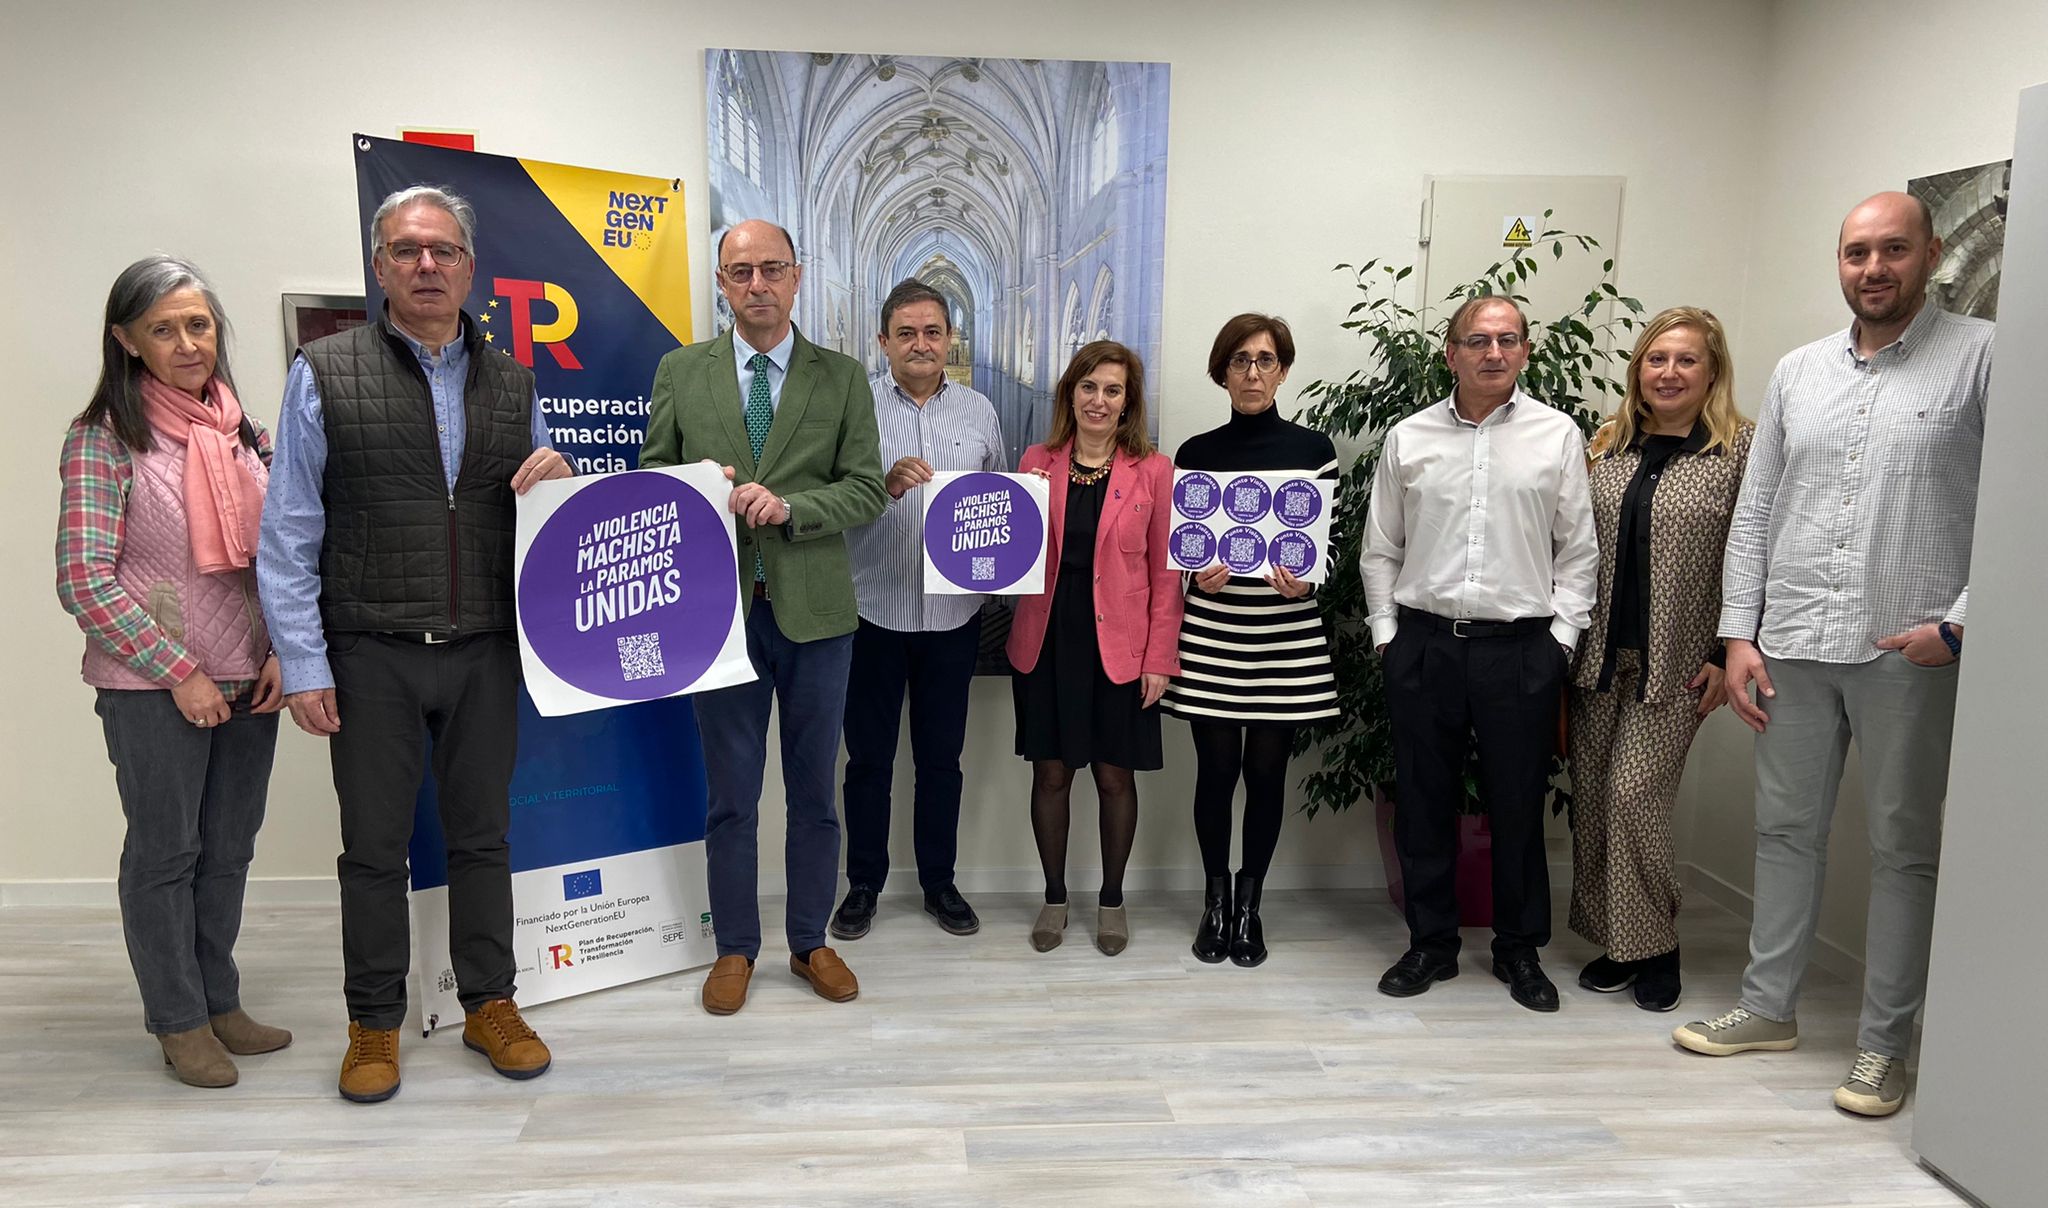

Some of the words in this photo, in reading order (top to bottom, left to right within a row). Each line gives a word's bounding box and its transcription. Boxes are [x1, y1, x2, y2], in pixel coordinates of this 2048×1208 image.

[603, 229, 632, 248] EU
[1180, 474, 1198, 485] Punto
[1200, 474, 1217, 490] Violeta
[1230, 478, 1248, 489] Punto
[1250, 477, 1267, 493] Violeta
[1280, 482, 1298, 493] Punto
[1300, 481, 1317, 498] Violeta
[962, 489, 1010, 507] VIOLENCIA
[954, 500, 1012, 522] MACHISTA
[579, 533, 592, 547] LA
[593, 501, 678, 542] VIOLENCIA
[964, 515, 1008, 532] PARAMOS
[577, 521, 681, 574] MACHISTA
[952, 525, 1011, 552] UNIDAS
[581, 580, 594, 594] LA
[597, 548, 674, 589] PARAMOS
[575, 569, 681, 632] UNIDAS
[543, 791, 551, 801] Y
[553, 784, 619, 800] TERRITORIAL
[516, 912, 561, 927] Financiado
[563, 908, 578, 919] por
[580, 906, 588, 914] la
[590, 901, 615, 912] Unión
[617, 895, 650, 906] Europea
[546, 910, 626, 933] NextGenerationEU
[579, 938, 594, 947] Plan
[606, 926, 655, 940] Recuperación,
[662, 931, 684, 943] SEPE
[580, 938, 633, 955] Transformación
[586, 949, 624, 962] Resiliencia
